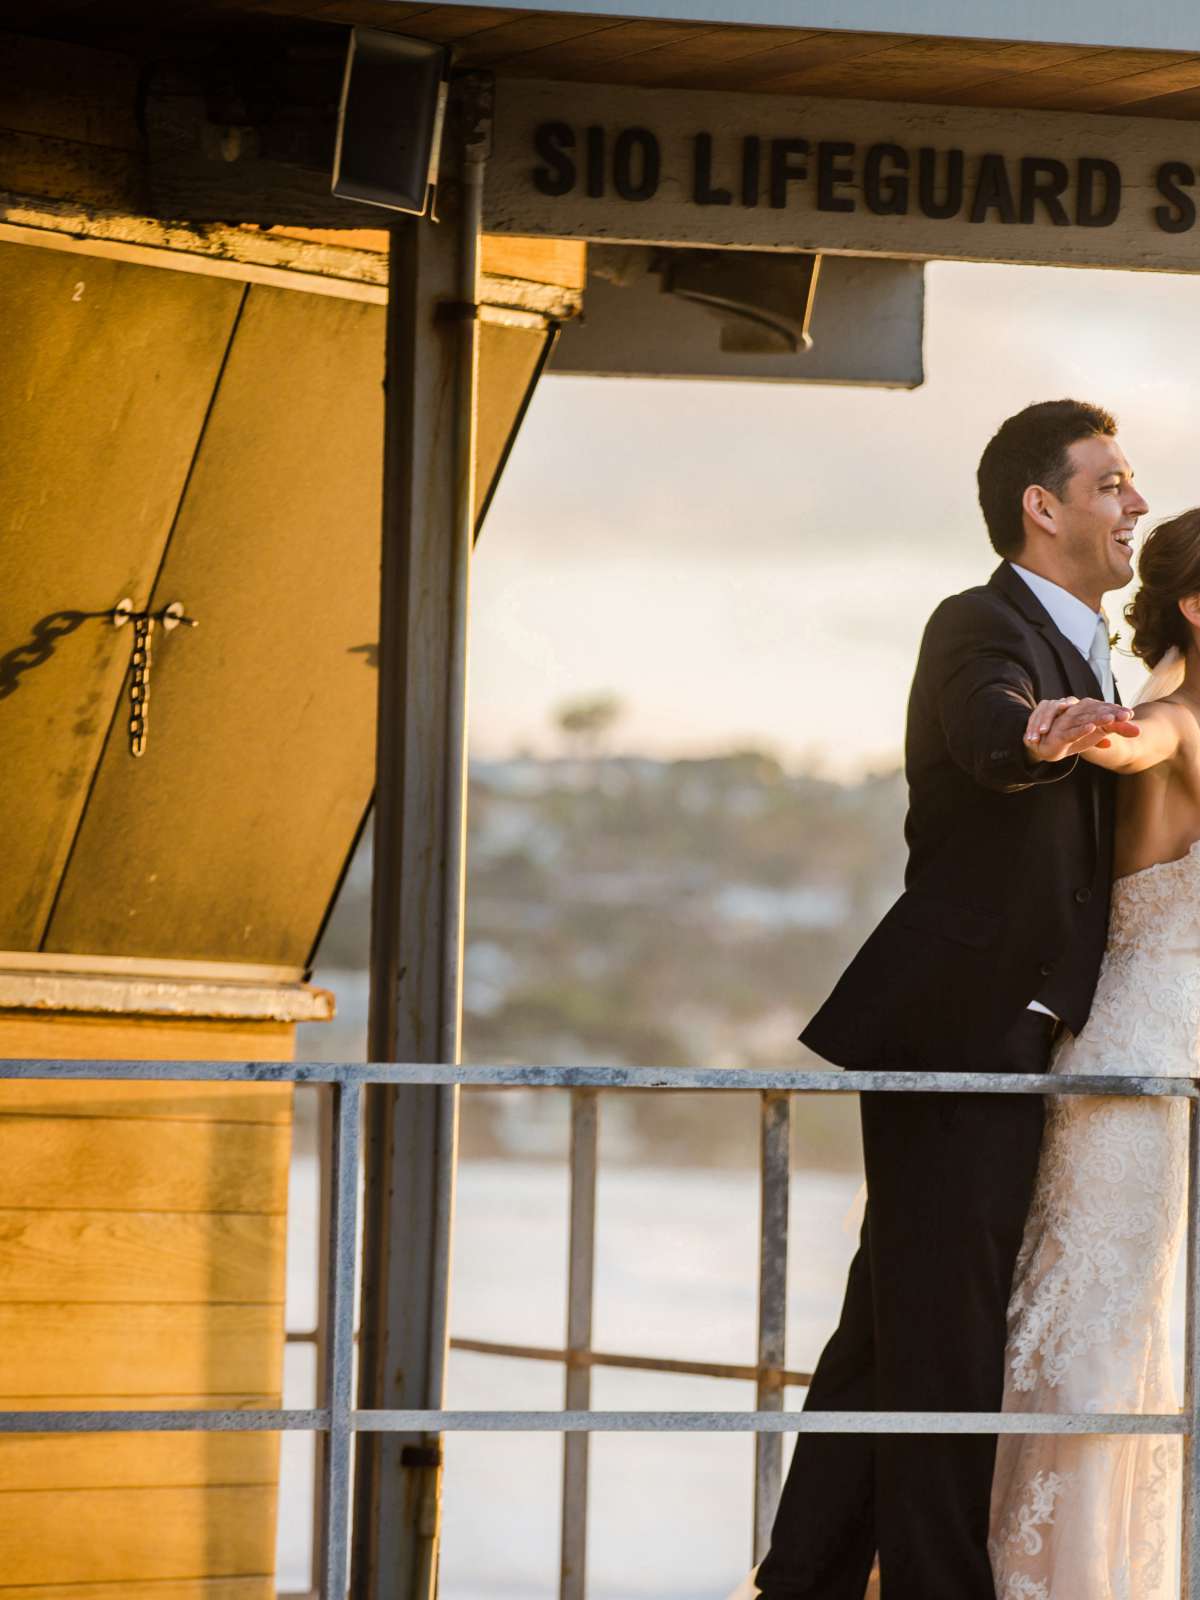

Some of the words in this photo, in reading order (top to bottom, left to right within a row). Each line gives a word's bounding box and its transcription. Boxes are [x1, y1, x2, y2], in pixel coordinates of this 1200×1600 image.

[532, 121, 661, 201] SIO
[694, 132, 1122, 227] LIFEGUARD
[72, 281, 85, 302] 2
